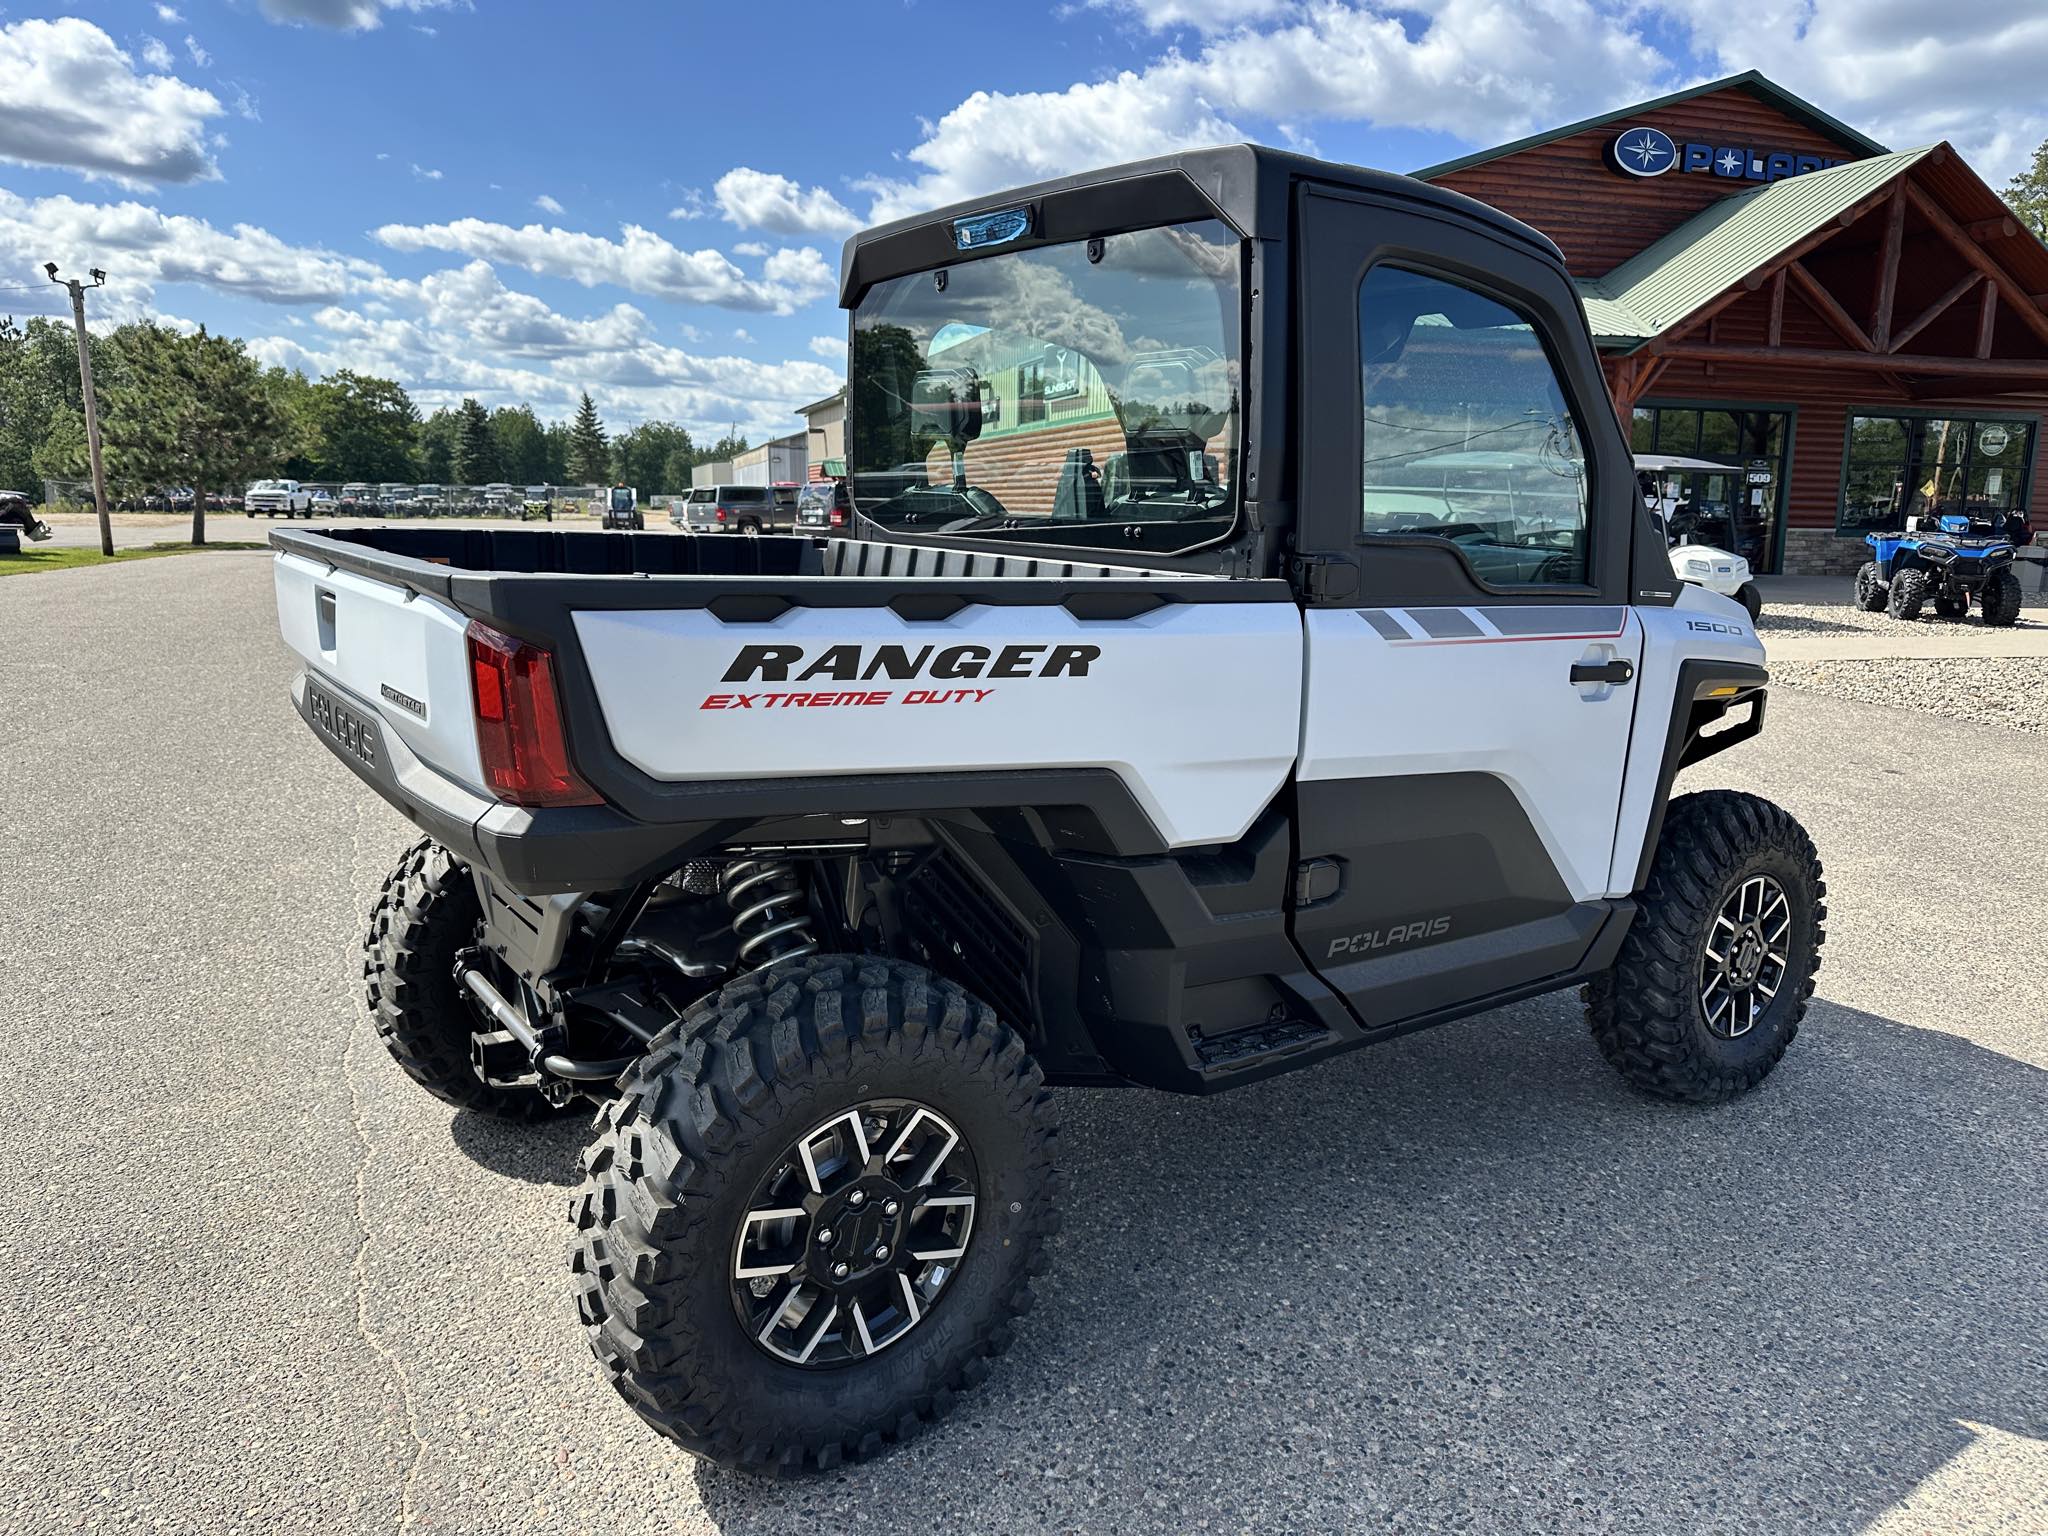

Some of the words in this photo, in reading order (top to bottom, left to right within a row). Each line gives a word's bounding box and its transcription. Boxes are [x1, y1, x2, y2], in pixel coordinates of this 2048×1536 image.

[1684, 143, 1849, 182] POLAR
[1686, 621, 1743, 635] 1500
[720, 645, 1101, 682] RANGER
[381, 684, 423, 717] NORTHSTAR
[699, 691, 893, 710] EXTREME
[901, 689, 997, 705] DUTY
[309, 686, 376, 769] POLARIS
[1327, 915, 1452, 958] POLARIS
